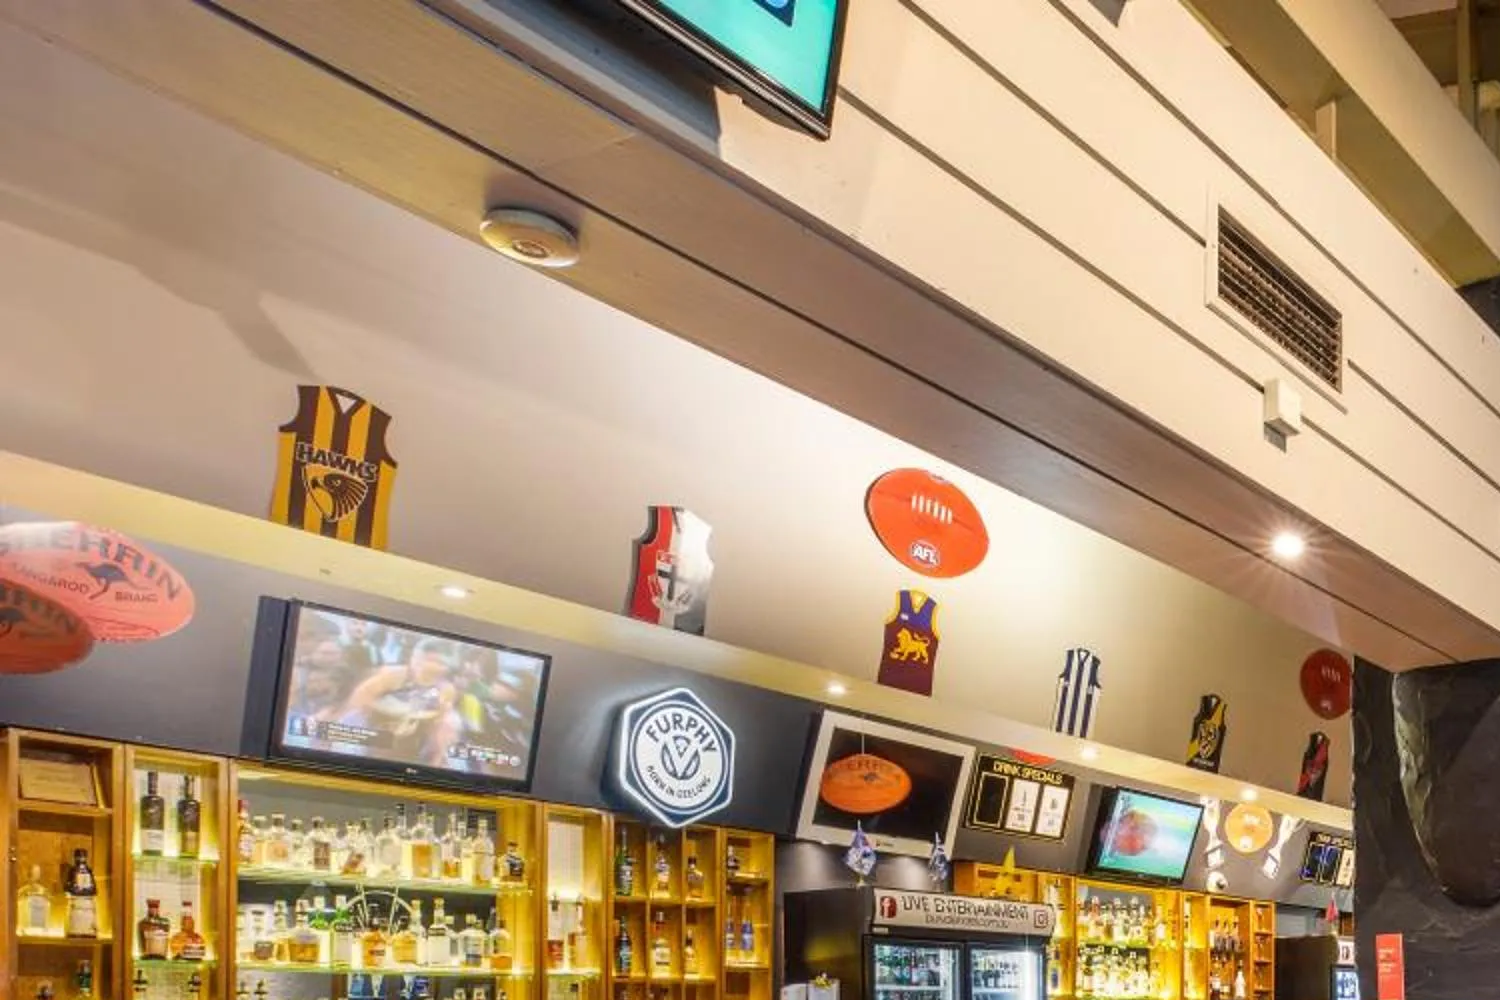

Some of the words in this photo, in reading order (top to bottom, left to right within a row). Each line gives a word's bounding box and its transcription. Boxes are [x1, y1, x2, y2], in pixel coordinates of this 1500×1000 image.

[296, 441, 378, 482] HAWKS
[912, 544, 938, 565] AFL
[645, 713, 718, 753] FURPHY
[993, 760, 1021, 776] DRINK
[1022, 767, 1063, 785] SPECIALS
[666, 786, 675, 797] IN
[901, 895, 930, 913] LIVE
[934, 897, 1029, 921] ENTERTAINMENT
